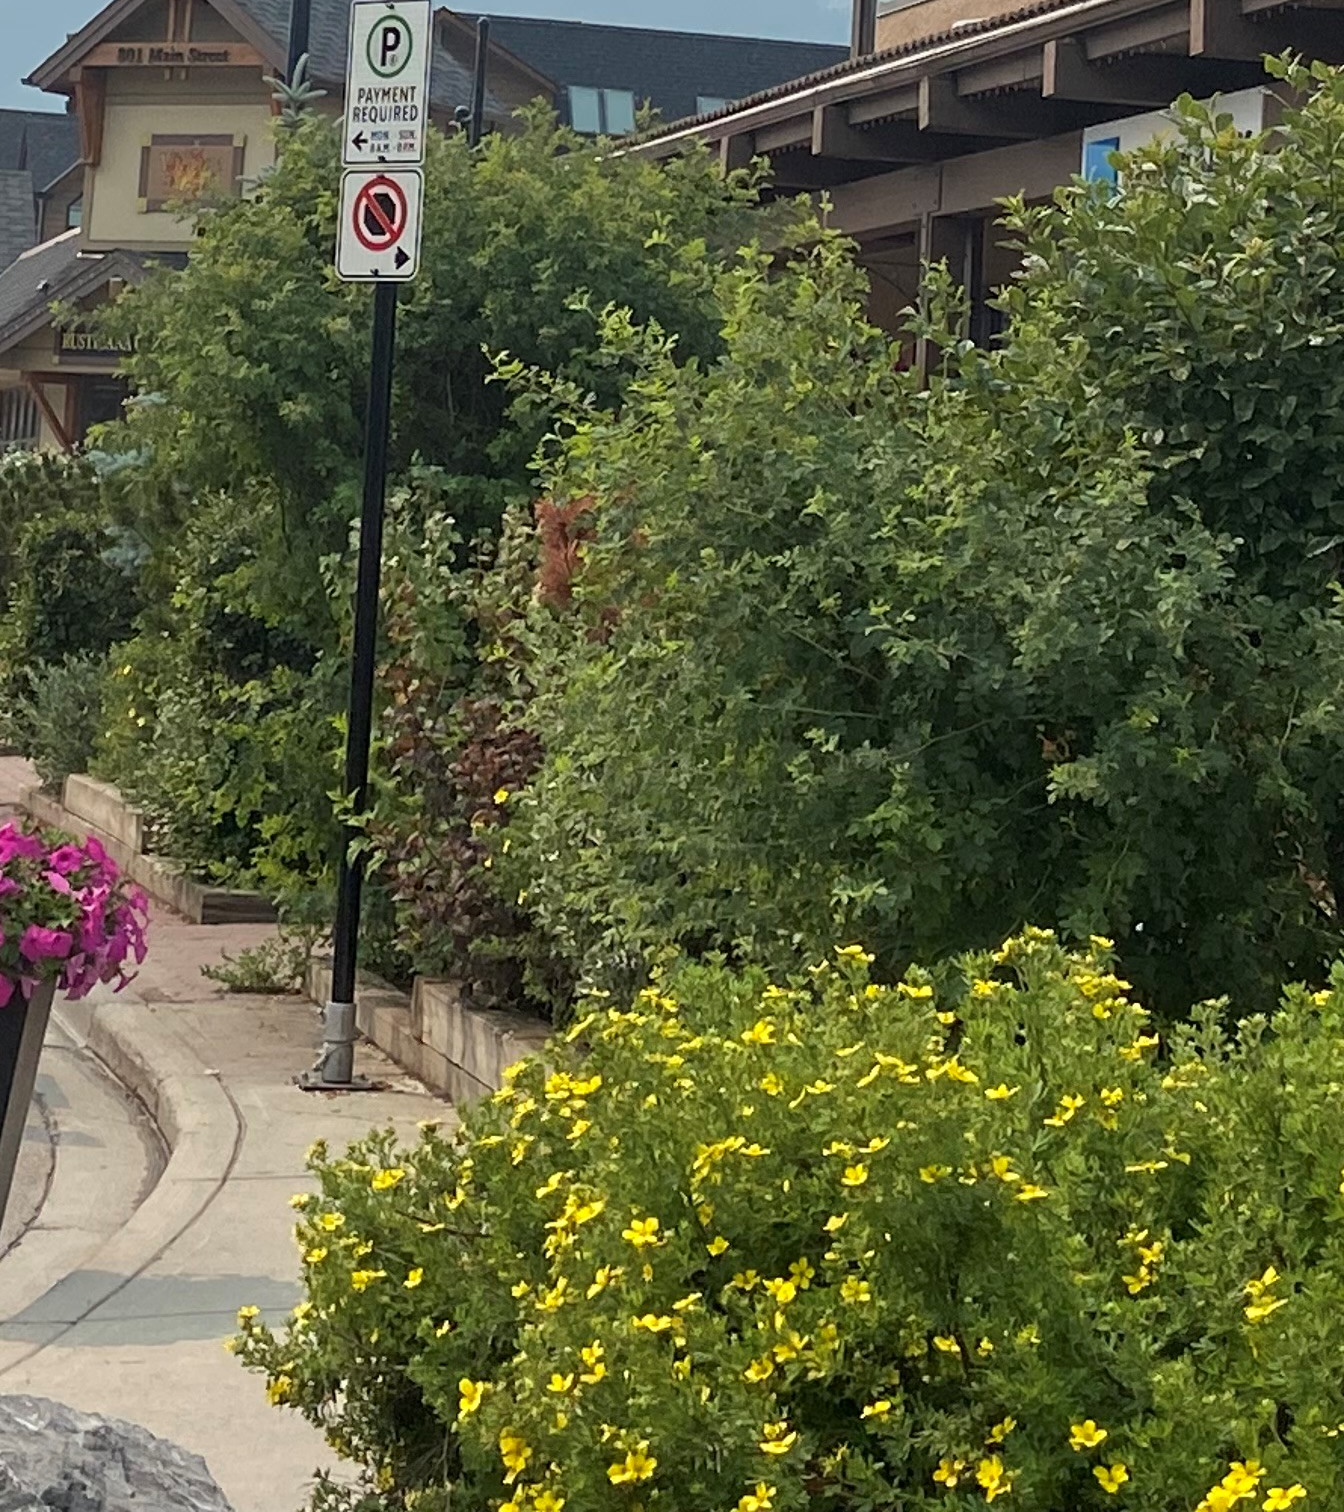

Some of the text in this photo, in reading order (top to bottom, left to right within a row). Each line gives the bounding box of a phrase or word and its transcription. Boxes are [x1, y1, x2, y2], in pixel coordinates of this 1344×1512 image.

[149, 45, 184, 63] Main
[188, 47, 231, 63] Street
[357, 85, 417, 104] PAYMENT
[352, 104, 419, 124] REQUIRED
